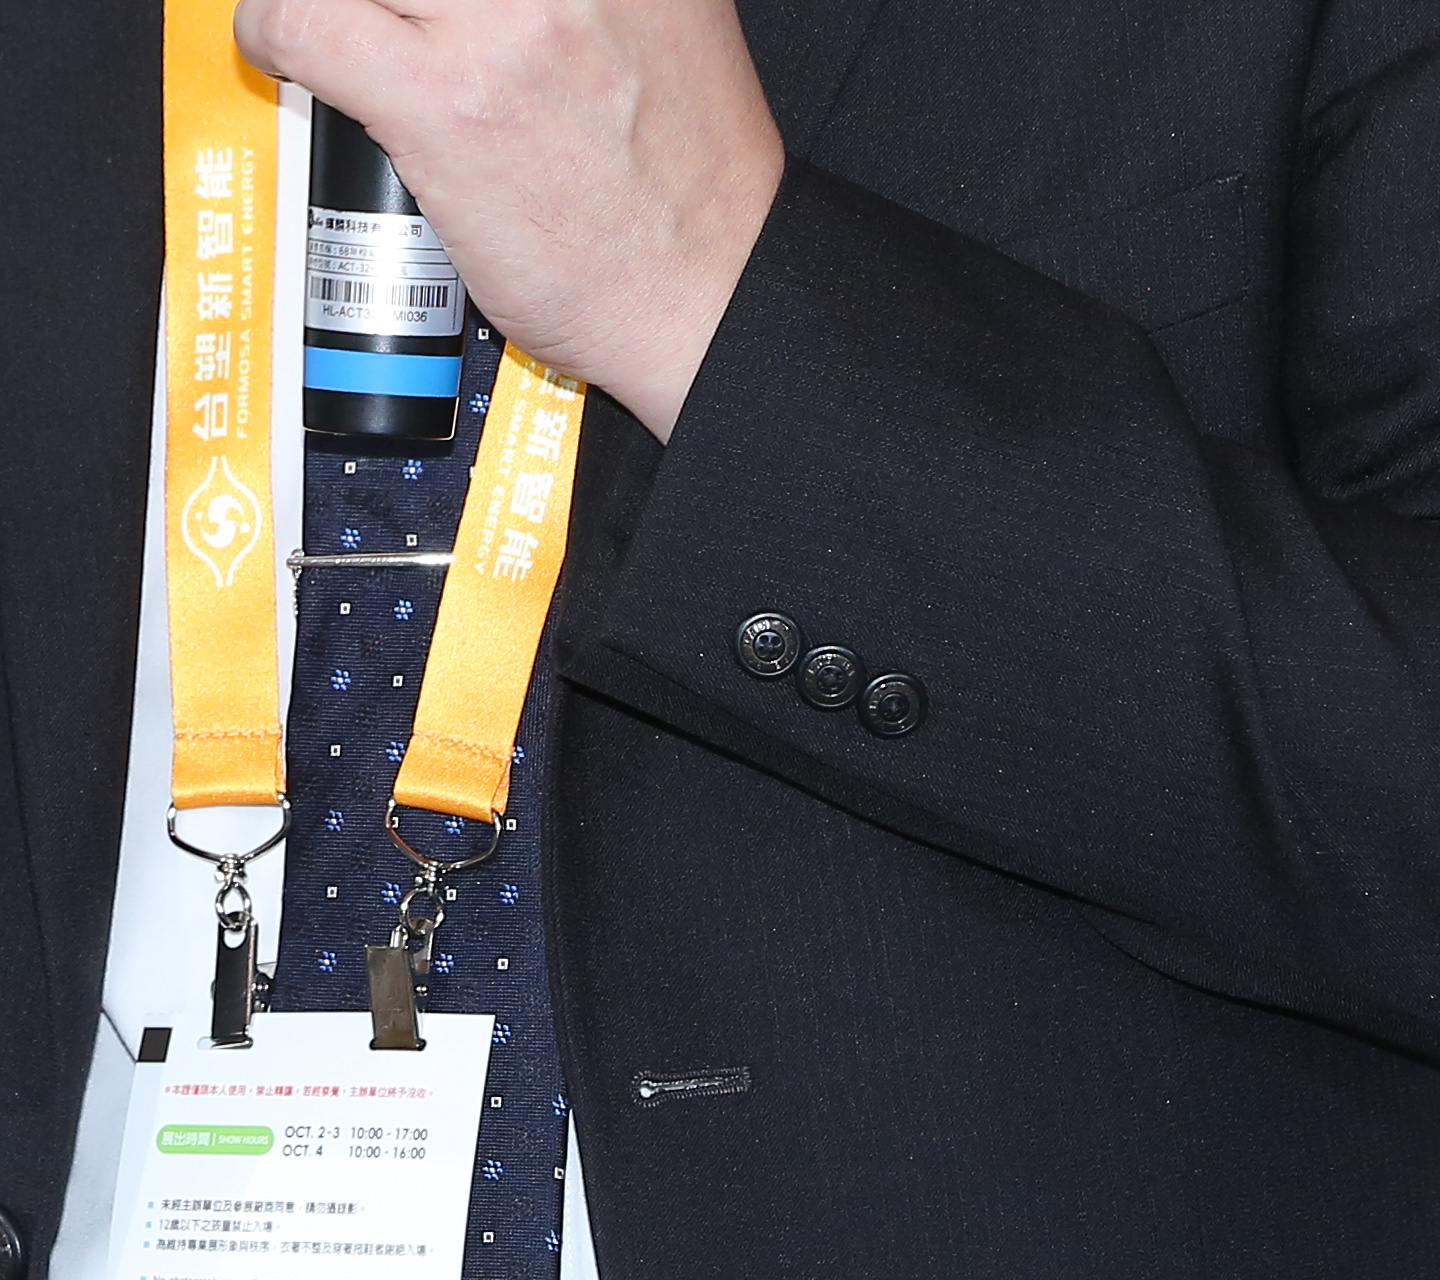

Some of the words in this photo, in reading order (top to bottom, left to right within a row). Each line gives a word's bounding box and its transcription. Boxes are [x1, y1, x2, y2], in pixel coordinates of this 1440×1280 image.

[241, 145, 256, 236] ENERGY
[192, 146, 234, 442] 台塑新智能
[240, 244, 255, 321] SMART
[236, 328, 252, 440] FORMOSA
[499, 398, 527, 479] SMART
[475, 485, 506, 575] ENERGY
[161, 1131, 211, 1147] 展出時間
[282, 1144, 312, 1157] OCT.
[315, 1144, 324, 1157] 4
[349, 1145, 381, 1158] 10:00
[393, 1146, 426, 1159] 16:00
[285, 1125, 314, 1139] OCT.
[318, 1126, 340, 1139] 2-3
[351, 1126, 383, 1140] 10:00
[395, 1127, 429, 1141] 17:00
